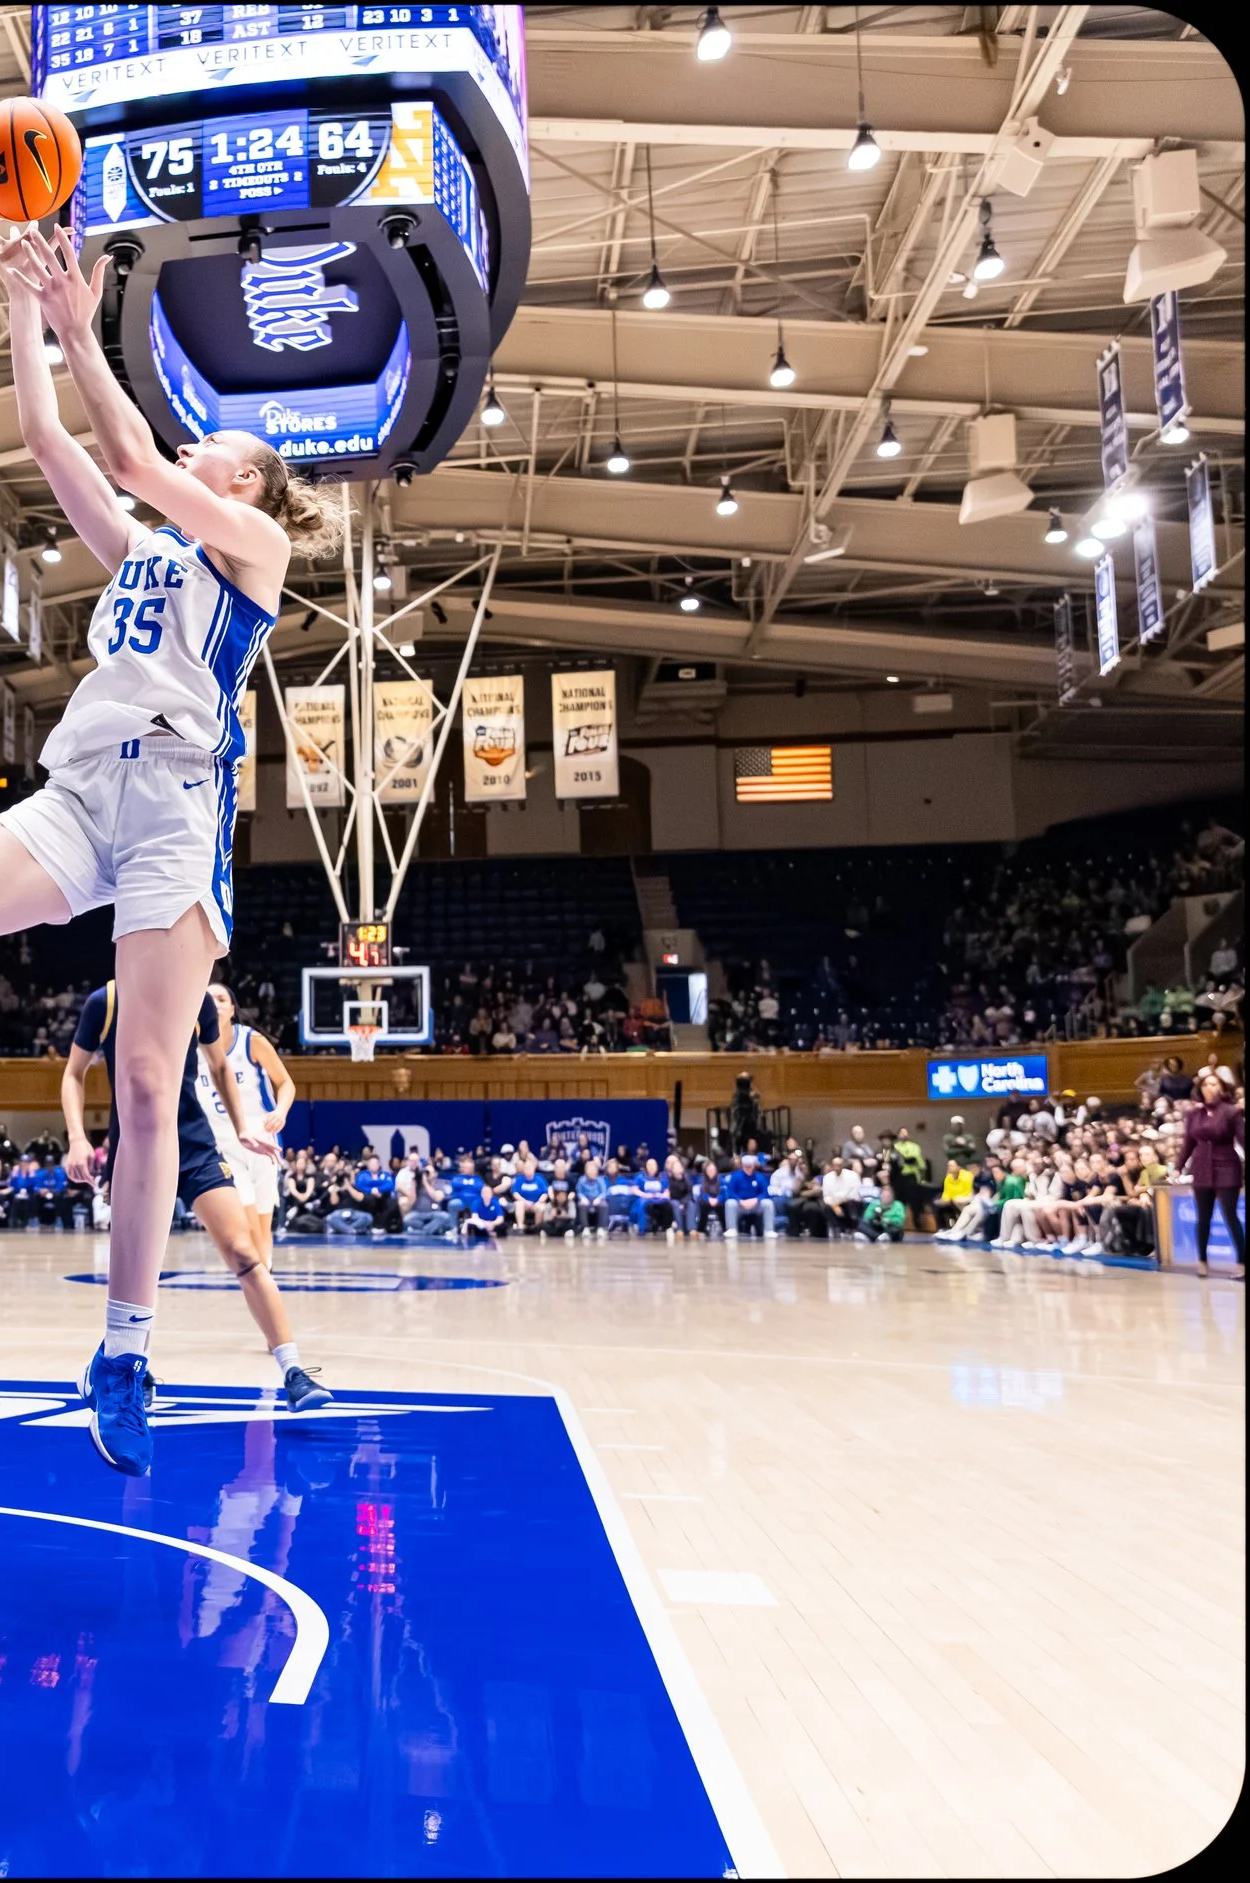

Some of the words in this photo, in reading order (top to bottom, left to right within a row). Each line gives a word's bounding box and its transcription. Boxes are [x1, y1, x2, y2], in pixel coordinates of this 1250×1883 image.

[179, 10, 203, 25] 37
[389, 9, 411, 23] 10
[448, 7, 460, 21] 1
[51, 32, 70, 48] 22
[75, 27, 94, 42] 21
[129, 18, 139, 31] 1
[232, 21, 271, 39] AST
[339, 34, 452, 51] VERITEXT
[51, 53, 70, 69] 35
[104, 43, 114, 57] 7
[129, 39, 139, 53] 1
[197, 41, 307, 66] VERITEXT
[62, 58, 166, 89] VERITEXT
[210, 125, 304, 164] 1:24
[318, 120, 373, 160] 64
[141, 137, 194, 179] 75
[265, 415, 337, 434] STORES
[278, 434, 373, 457] duke.edu
[108, 597, 166, 655] 35
[562, 688, 606, 699] NATIONAL
[392, 778, 418, 789] 2001
[574, 772, 602, 783] 2015
[357, 925, 387, 942] 1:23
[981, 1062, 1025, 1078] North
[981, 1076, 1045, 1093] Carolina
